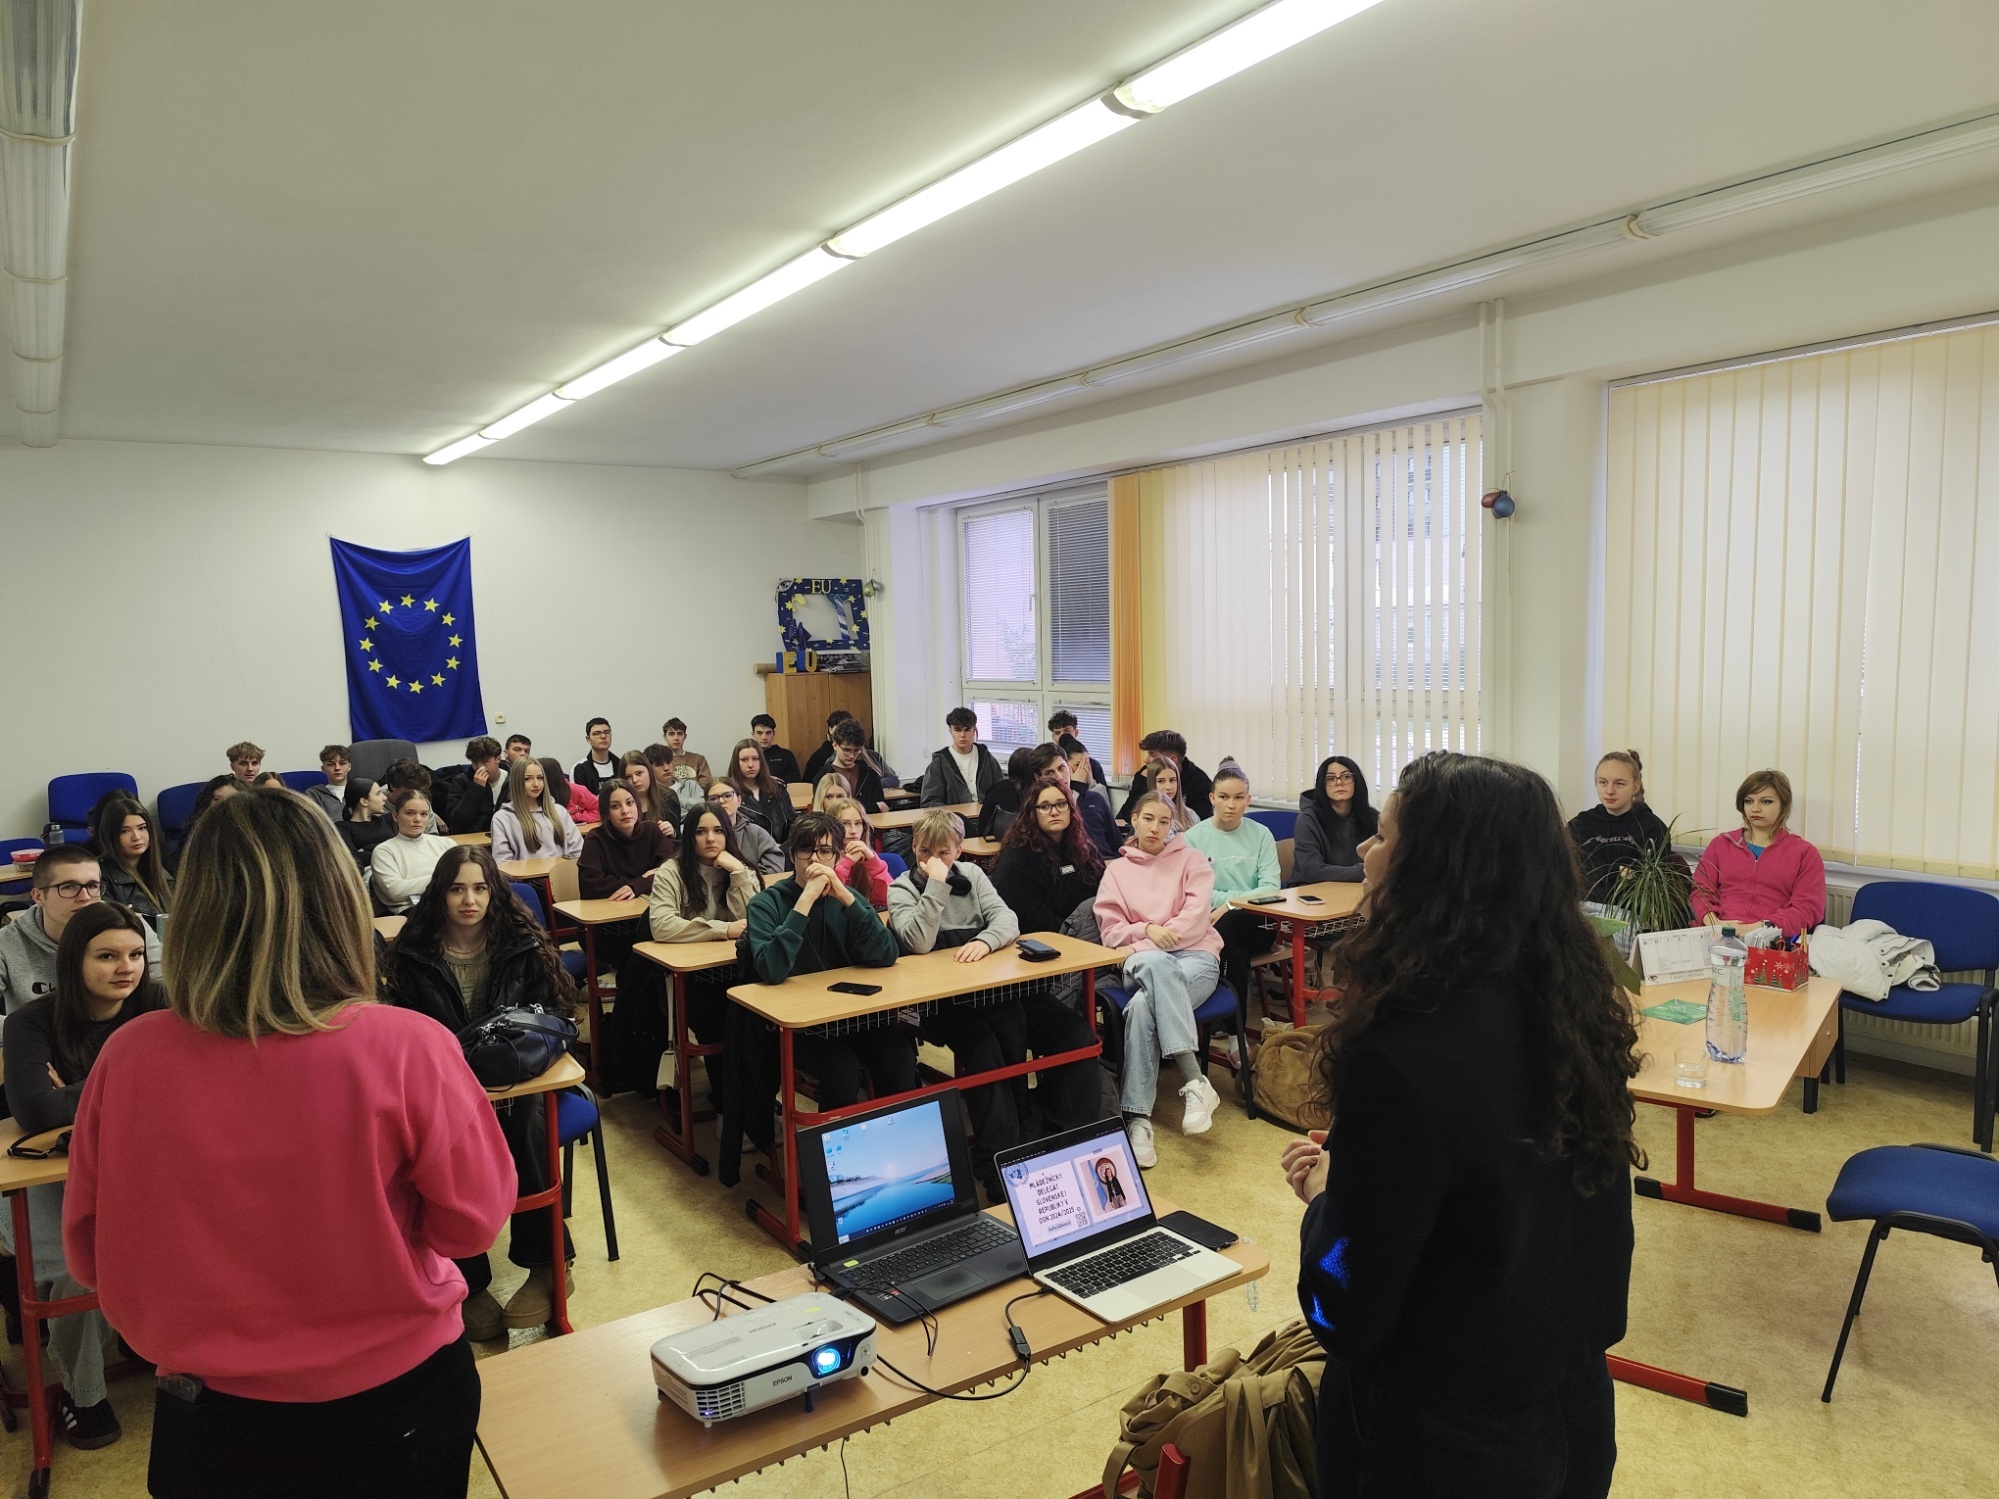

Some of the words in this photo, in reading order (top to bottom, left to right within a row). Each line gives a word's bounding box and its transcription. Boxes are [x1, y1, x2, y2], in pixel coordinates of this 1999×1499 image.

[811, 579, 832, 594] EU
[783, 650, 818, 673] EU
[1037, 1183, 1059, 1196] DELEGÁT
[1036, 1190, 1067, 1205] SLOVENSKEJ
[1038, 1201, 1064, 1215] REPUBLIKY
[1038, 1214, 1050, 1224] OSN
[1050, 1206, 1075, 1221] 2024/2025
[772, 1375, 793, 1387] EPSON
